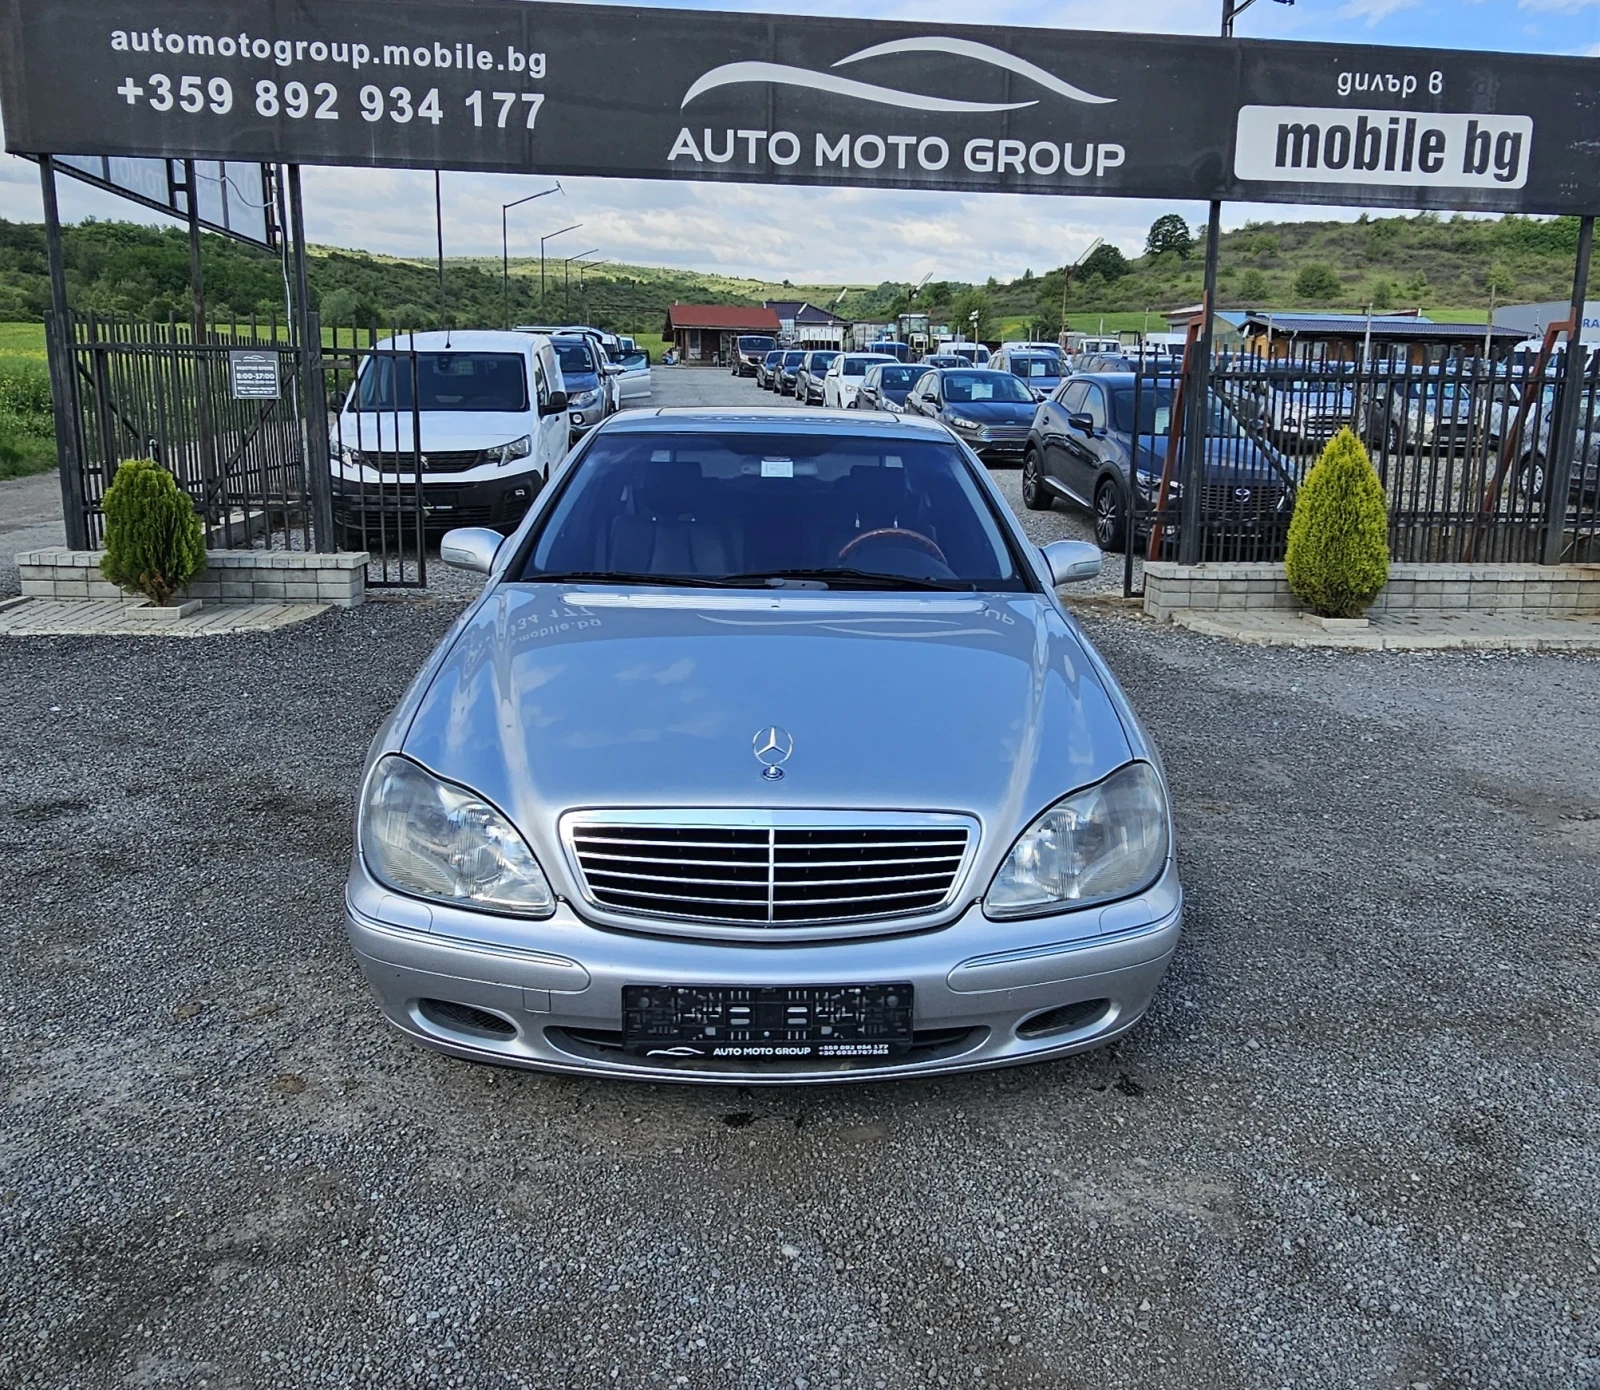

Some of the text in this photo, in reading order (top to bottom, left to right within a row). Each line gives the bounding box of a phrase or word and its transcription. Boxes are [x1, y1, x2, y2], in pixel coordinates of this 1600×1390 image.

[110, 27, 546, 79] automotogroup.mobile.bg
[117, 73, 545, 130] +359 892 934 177
[667, 127, 1126, 177] AUTO MOTO GROUP
[1274, 115, 1523, 183] mobile bg
[712, 1047, 743, 1056] AUTO
[743, 1047, 774, 1056] MOTO
[774, 1046, 811, 1056] GROUP
